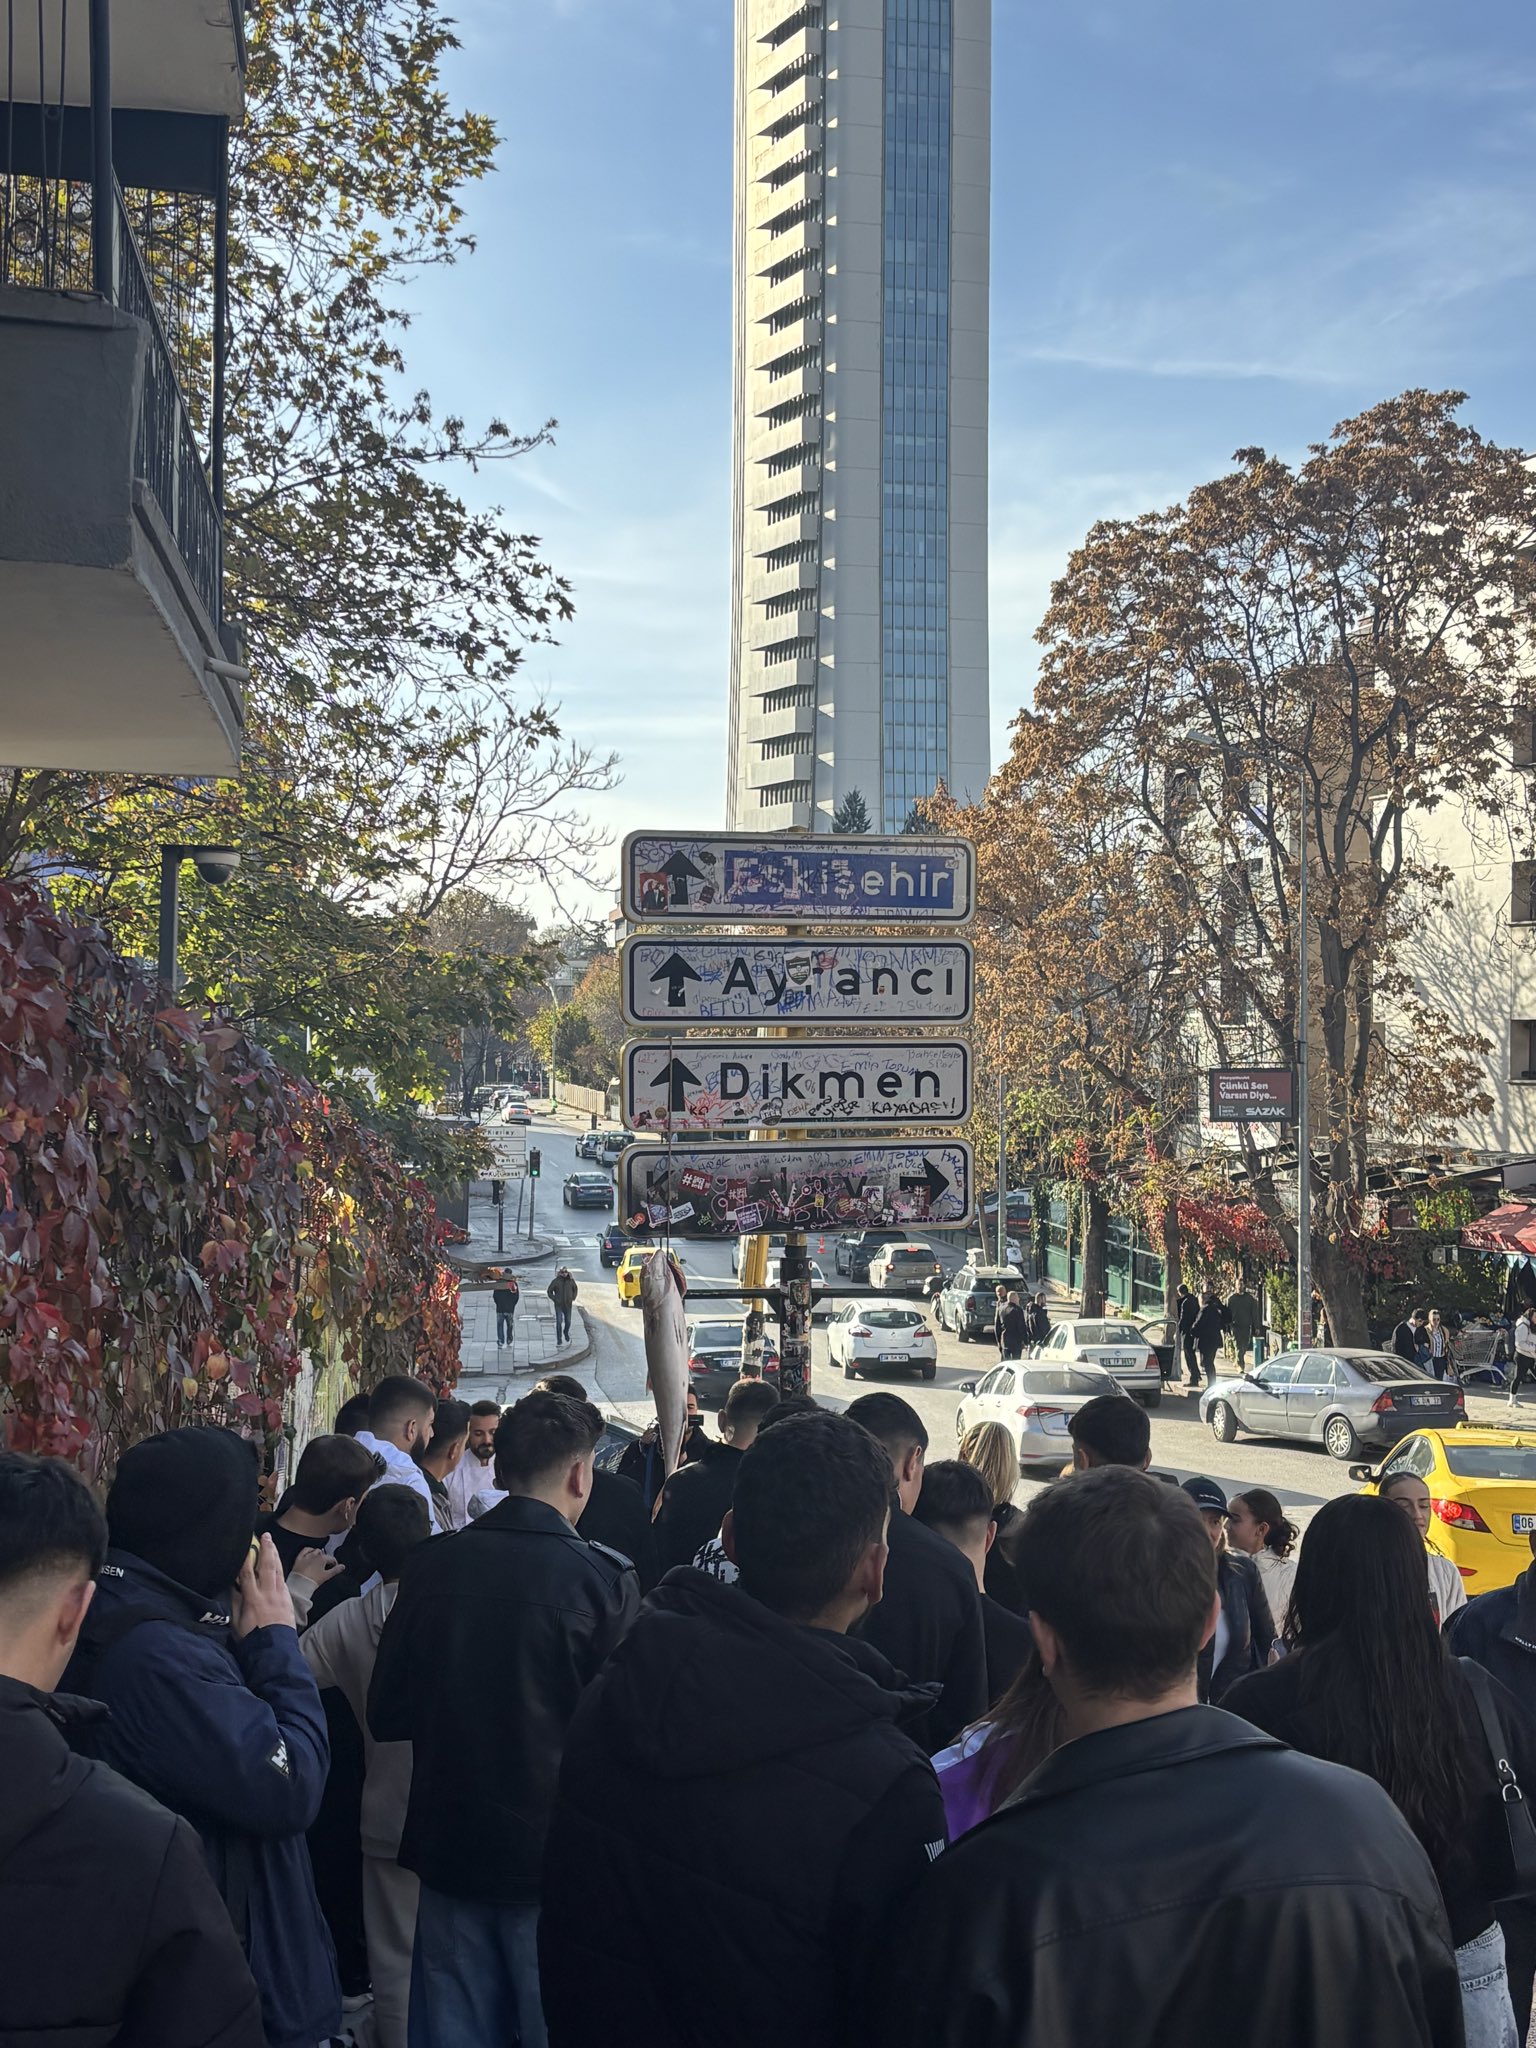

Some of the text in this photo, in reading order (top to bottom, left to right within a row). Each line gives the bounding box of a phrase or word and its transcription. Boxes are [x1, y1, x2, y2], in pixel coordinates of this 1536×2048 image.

[720, 1062, 940, 1100] Dikmen
[1219, 1081, 1269, 1091] Çünkü Sen
[1219, 1091, 1248, 1100] Varsın
[1245, 1106, 1286, 1116] SAZAK
[1521, 1516, 1534, 1529] 06
